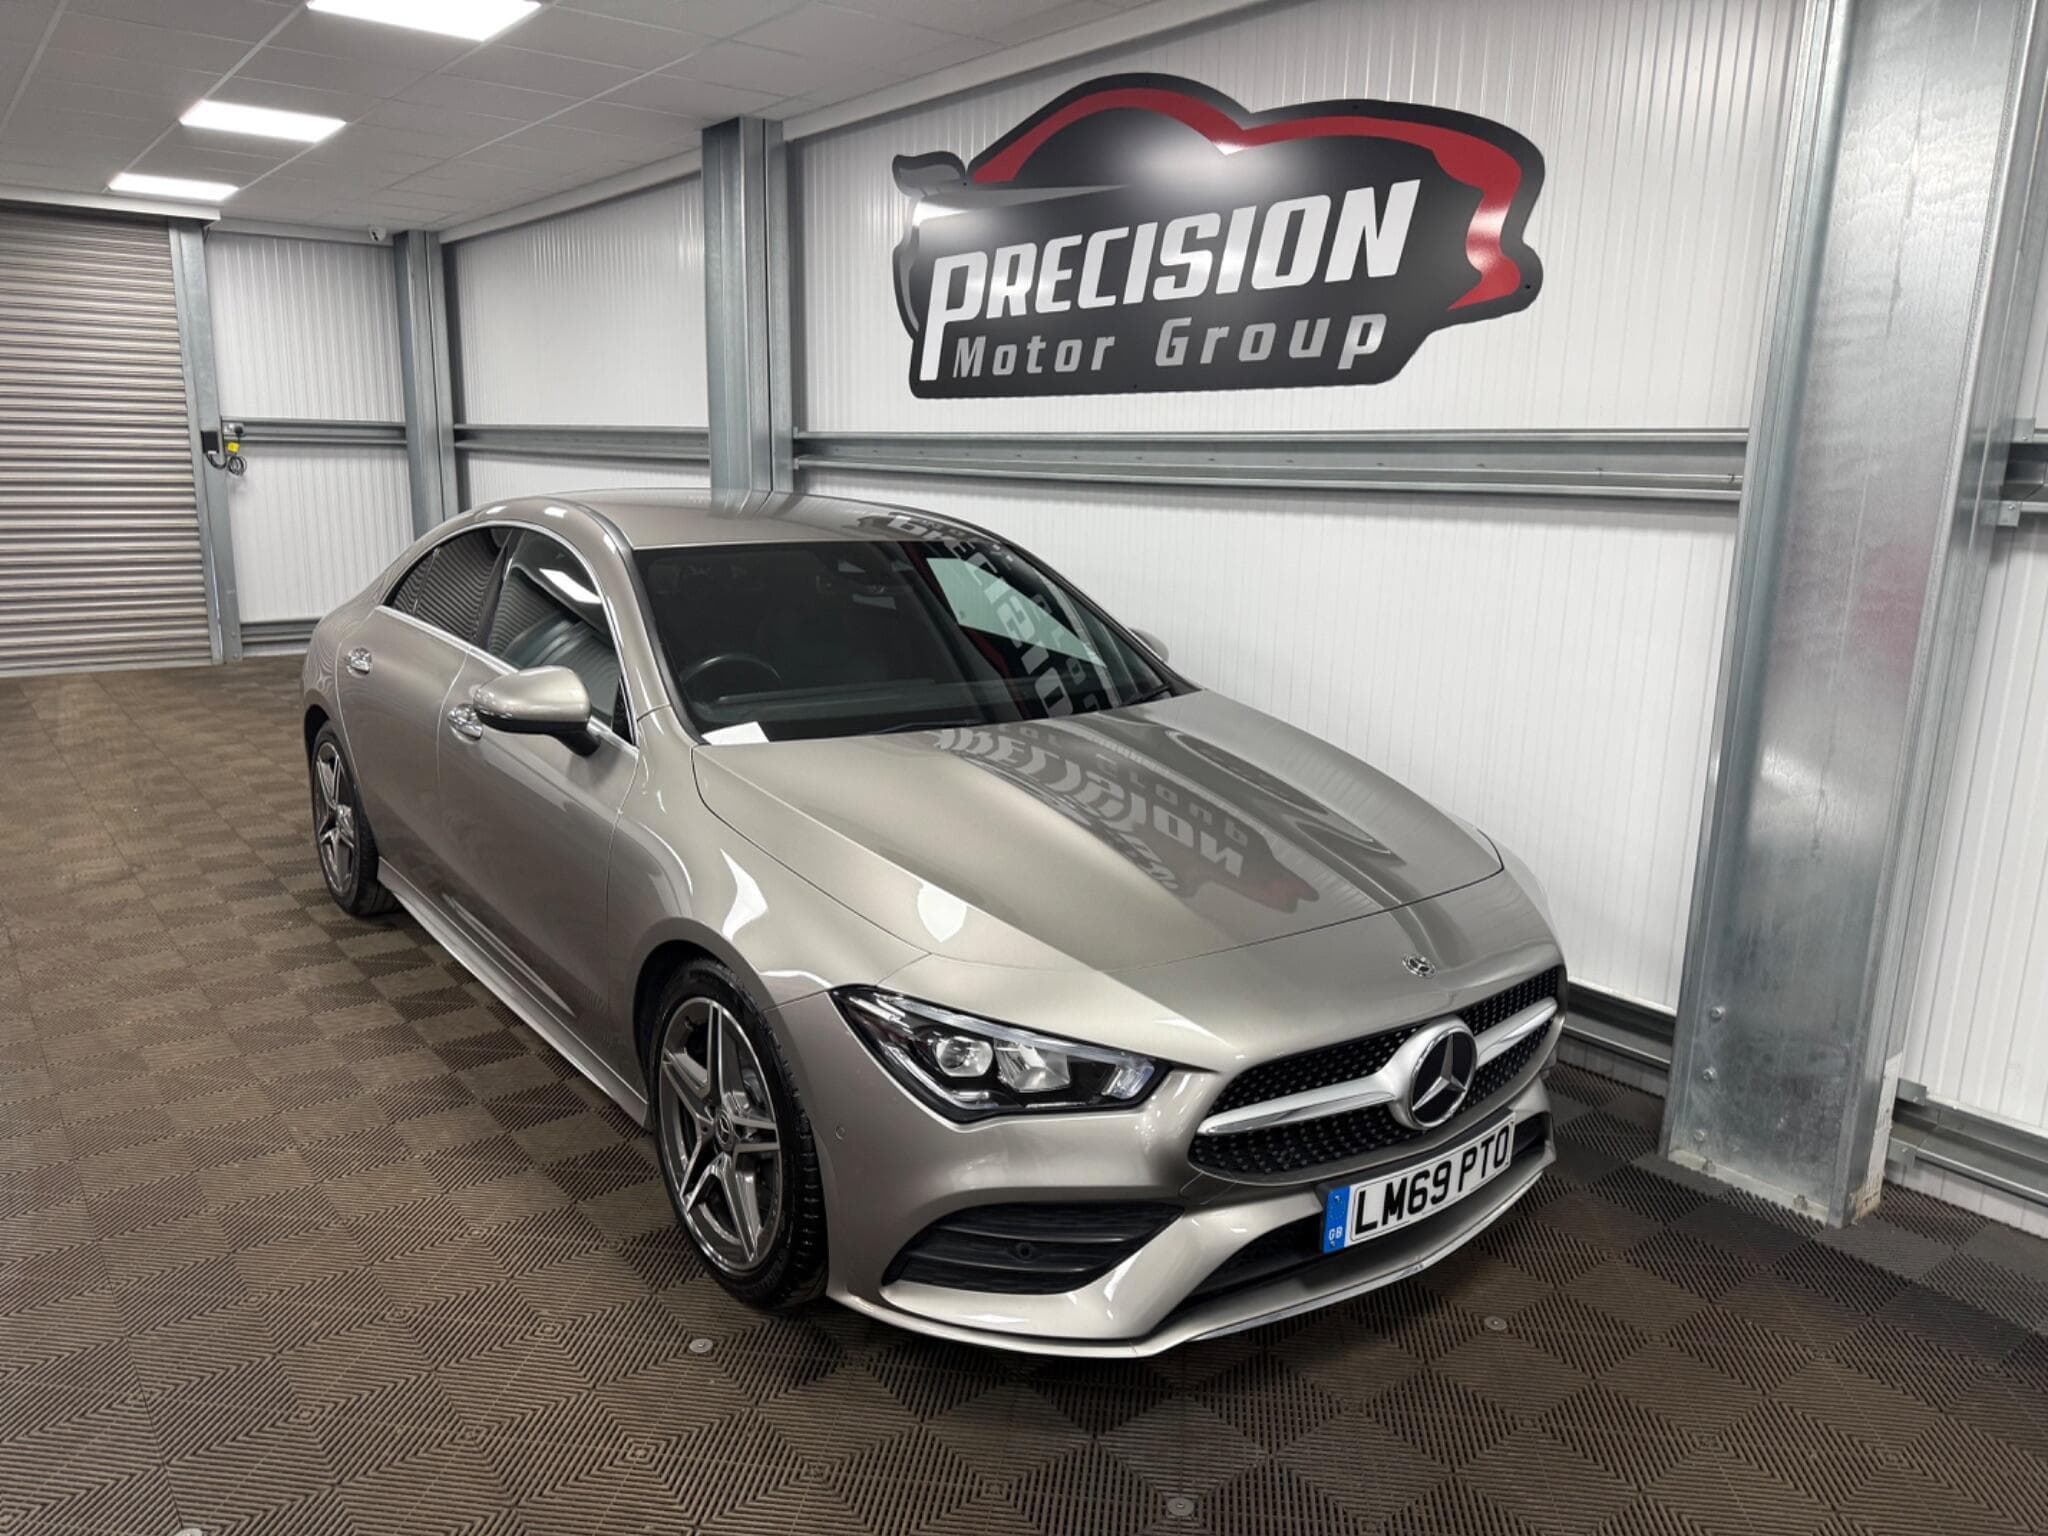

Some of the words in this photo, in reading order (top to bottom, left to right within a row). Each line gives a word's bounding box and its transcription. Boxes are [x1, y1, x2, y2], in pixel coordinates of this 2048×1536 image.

[919, 178, 1421, 381] PRECISION
[952, 334, 1116, 379] Motor
[1154, 313, 1388, 371] Group
[1354, 1161, 1453, 1236] LM69
[1457, 1125, 1510, 1193] PTO
[1328, 1226, 1343, 1241] GB
